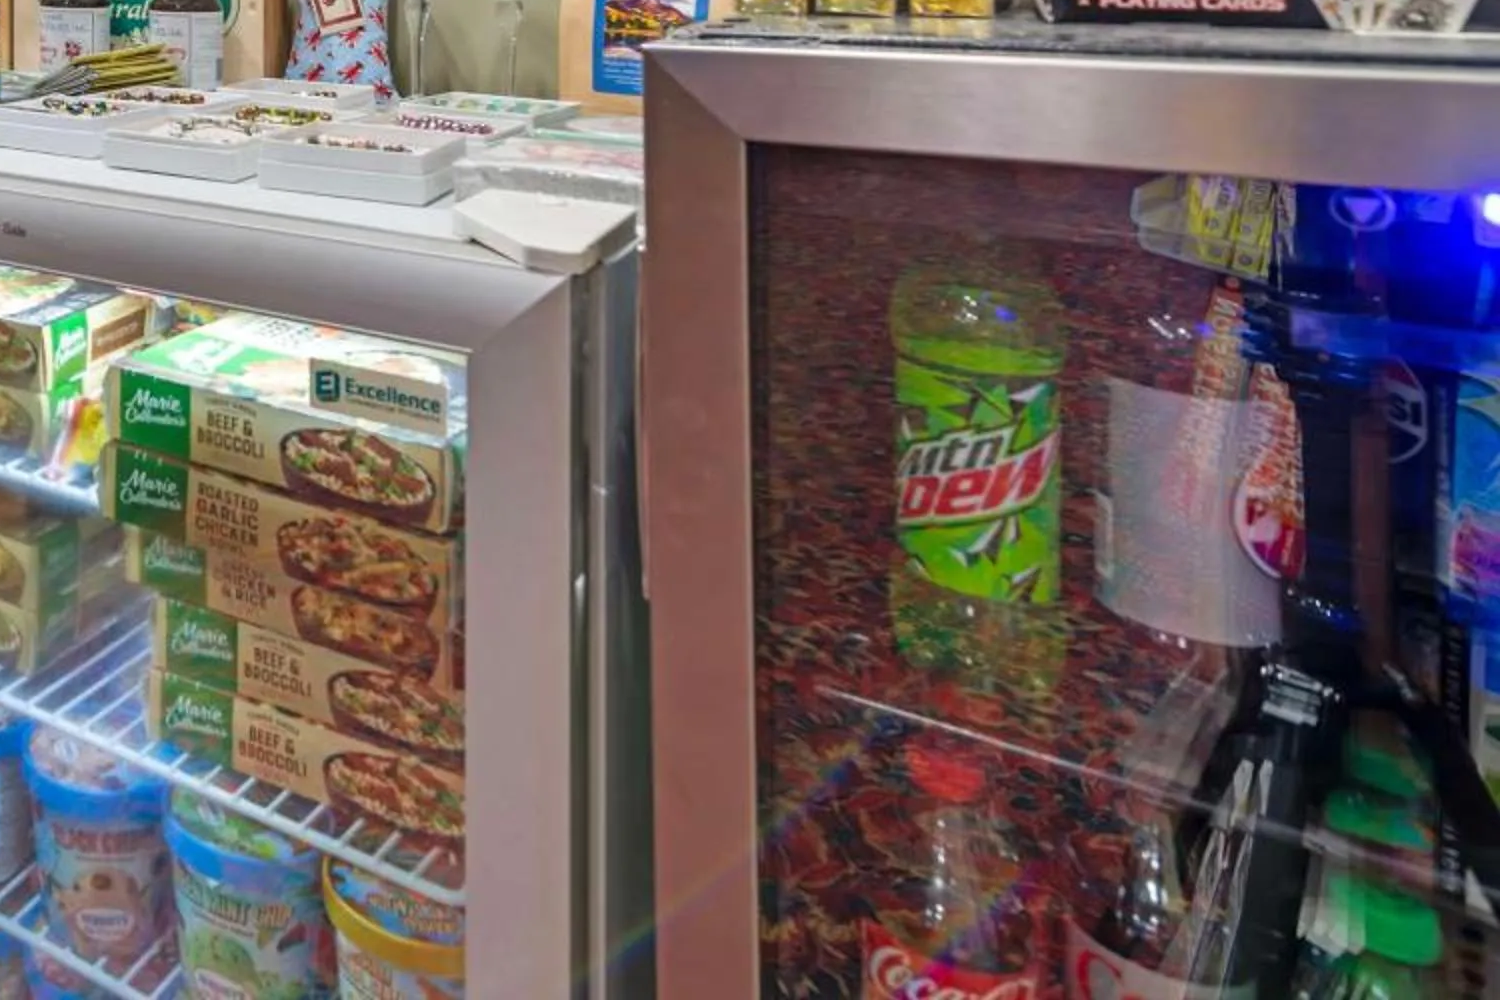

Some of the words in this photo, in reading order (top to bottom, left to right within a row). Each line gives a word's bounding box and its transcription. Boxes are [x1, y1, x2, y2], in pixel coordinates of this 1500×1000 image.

[126, 387, 182, 413] Marie
[345, 377, 441, 413] Excellence
[207, 411, 239, 433] BEEF
[197, 427, 265, 459] BROCCOLI
[122, 469, 180, 496] Marie
[198, 481, 260, 513] ROASTED
[196, 498, 260, 531] GARLIC
[195, 515, 260, 548] CHICKEN
[180, 621, 228, 647] Marie
[254, 647, 287, 673] BEEF
[244, 662, 312, 697] BROCCOLI
[175, 695, 223, 723] Marie
[250, 723, 282, 748] BEEF
[238, 739, 308, 778] BROCCOLI
